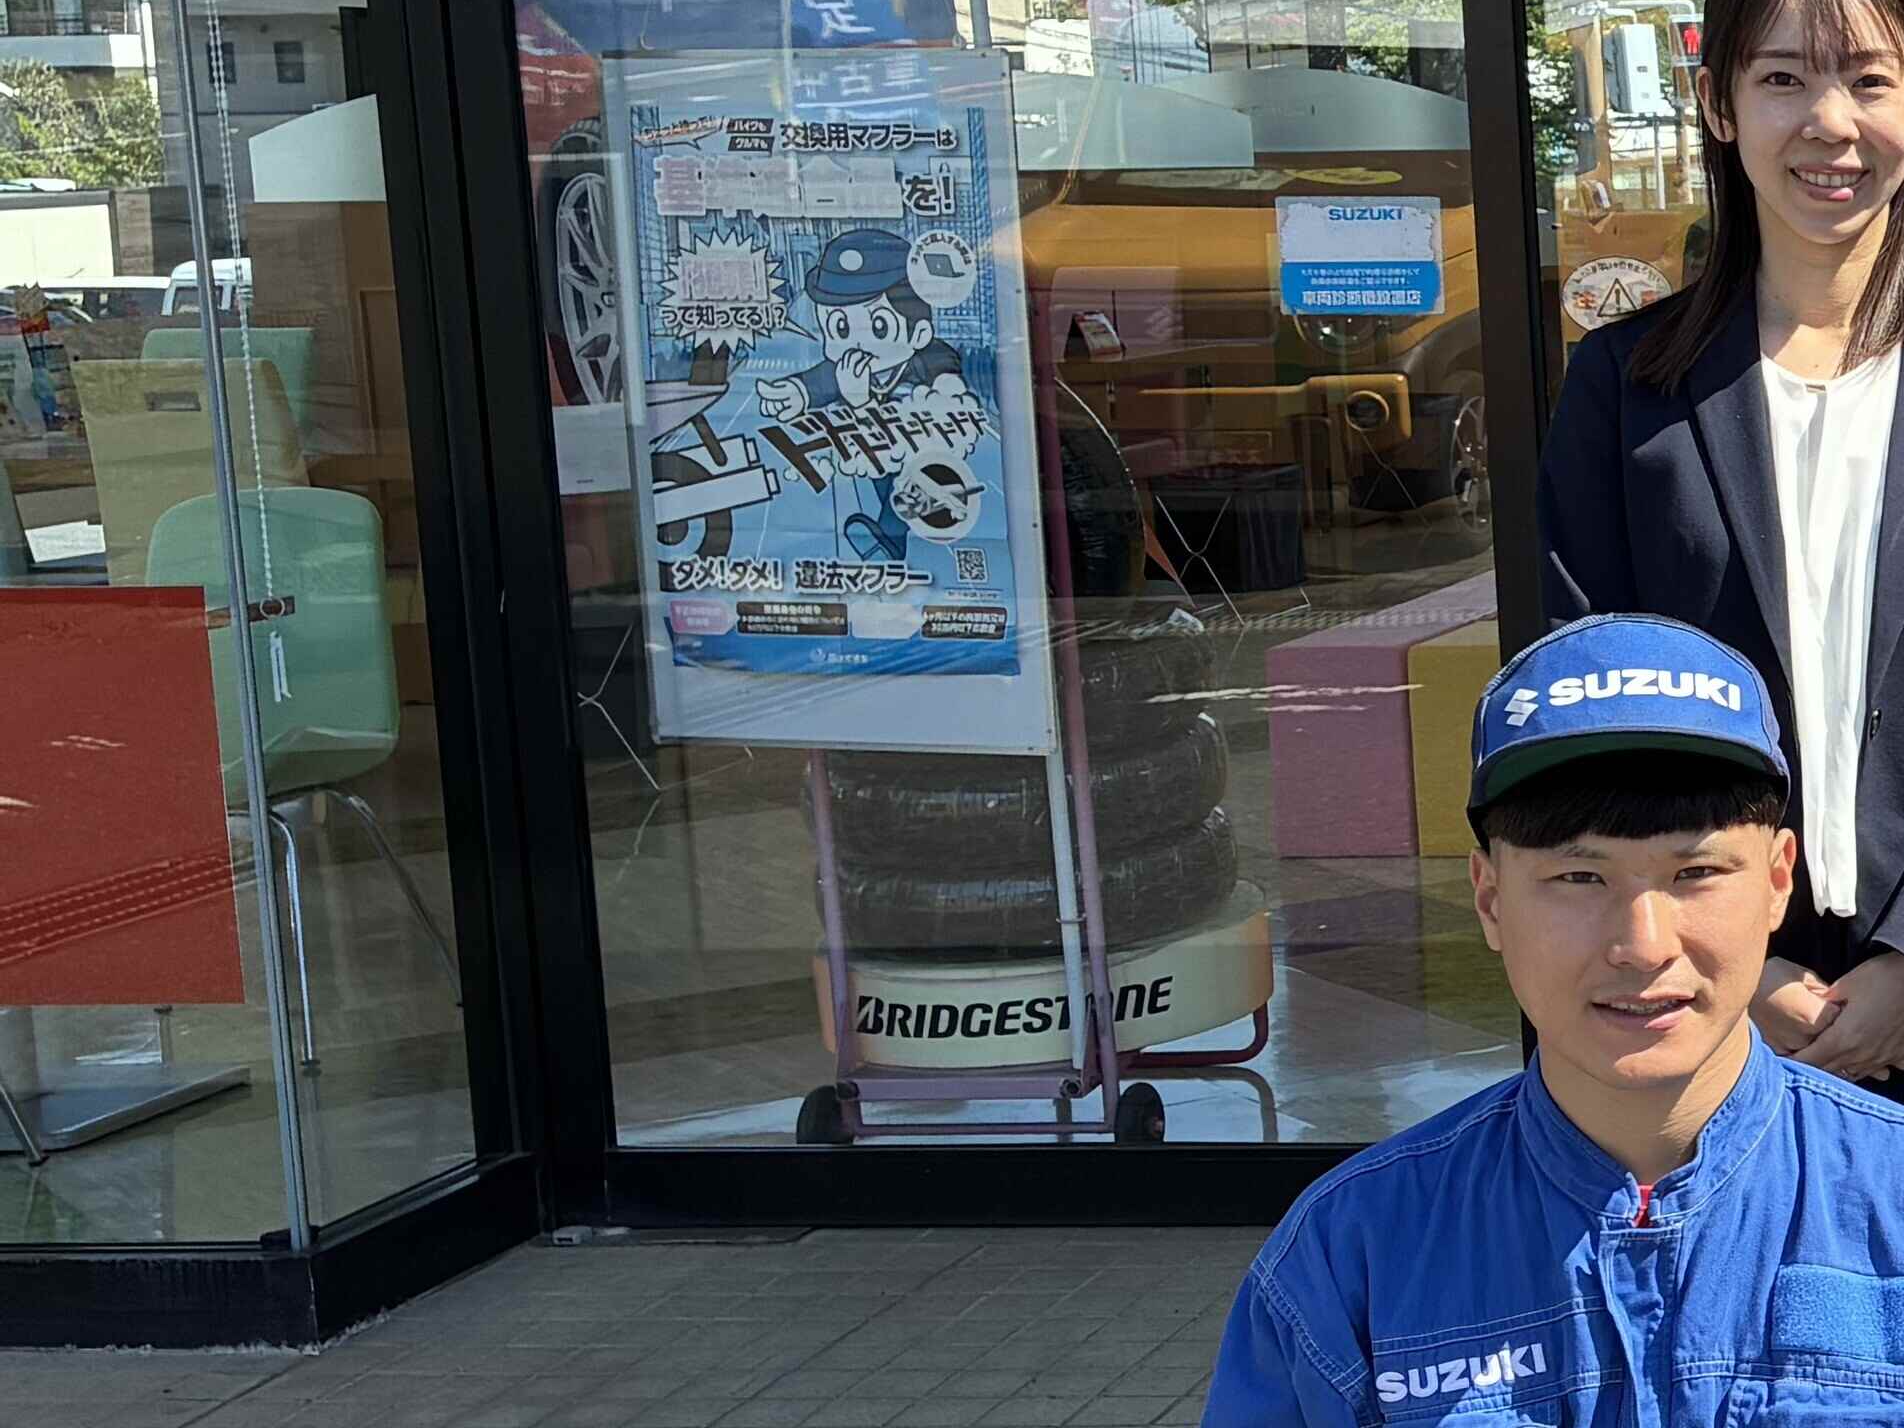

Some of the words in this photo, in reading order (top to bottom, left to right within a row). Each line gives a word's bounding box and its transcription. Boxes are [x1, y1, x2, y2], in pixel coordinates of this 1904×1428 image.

[780, 122, 958, 150] 交換用マフラーは
[1328, 208, 1403, 221] SUZUKI
[674, 557, 783, 589] ダメ!ダメ!
[795, 559, 932, 592] 違法マフラー
[1548, 668, 1741, 712] SUZUKI
[856, 976, 1173, 1039] BRIDGESTNE
[1376, 1341, 1546, 1403] SUZUKI
